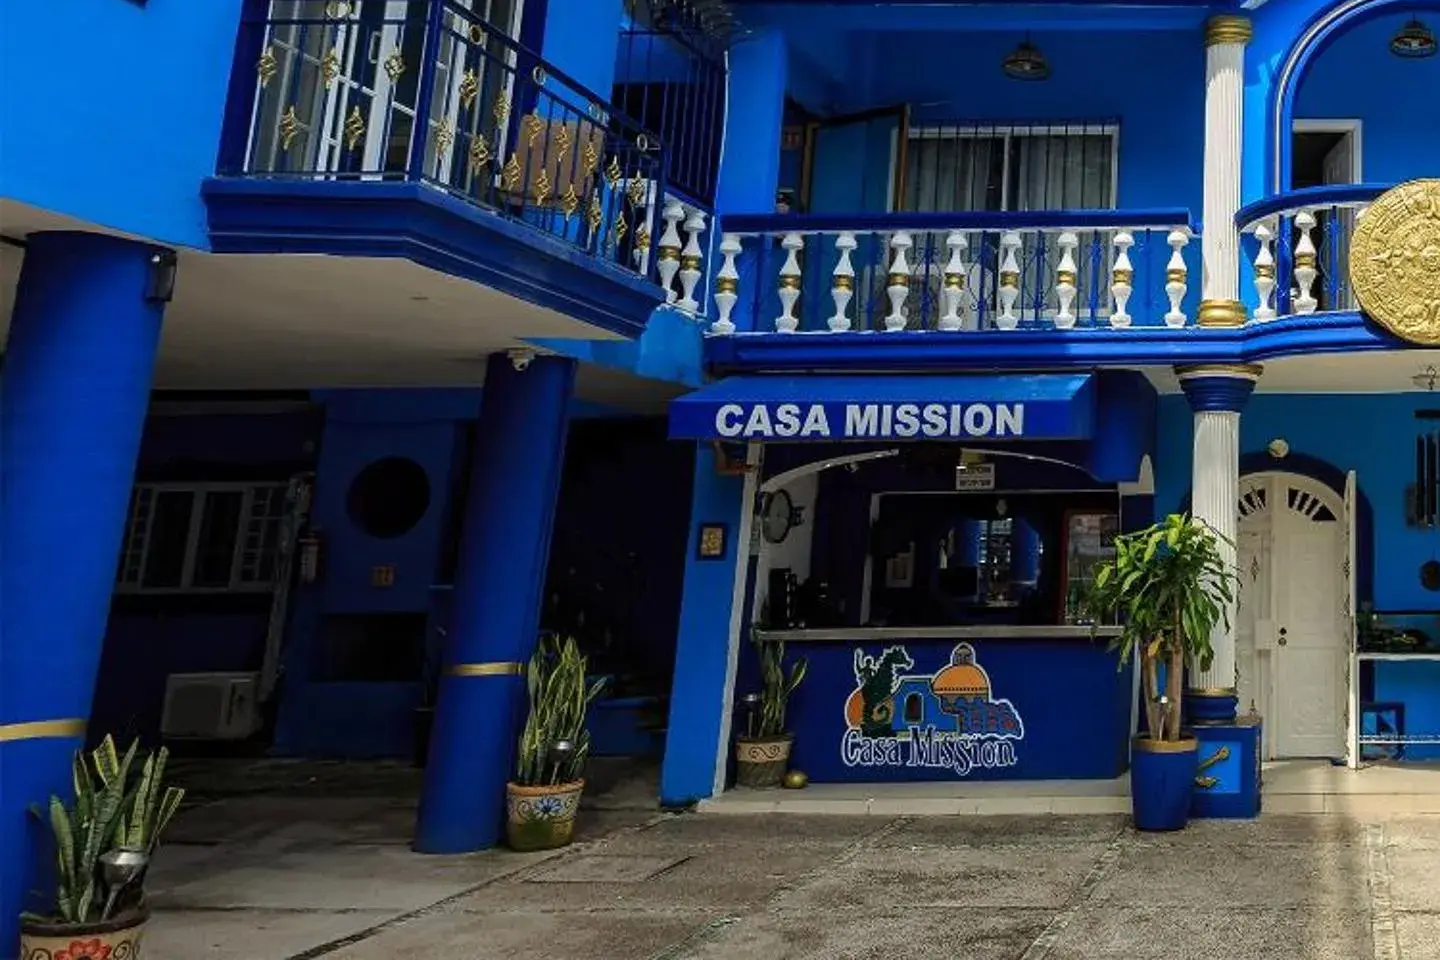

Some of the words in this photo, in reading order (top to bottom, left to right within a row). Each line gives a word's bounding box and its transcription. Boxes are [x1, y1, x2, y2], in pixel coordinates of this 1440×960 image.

[715, 403, 830, 437] CASA
[844, 403, 1024, 437] MISSION
[841, 728, 902, 766] Casa
[906, 724, 1018, 776] Mission
